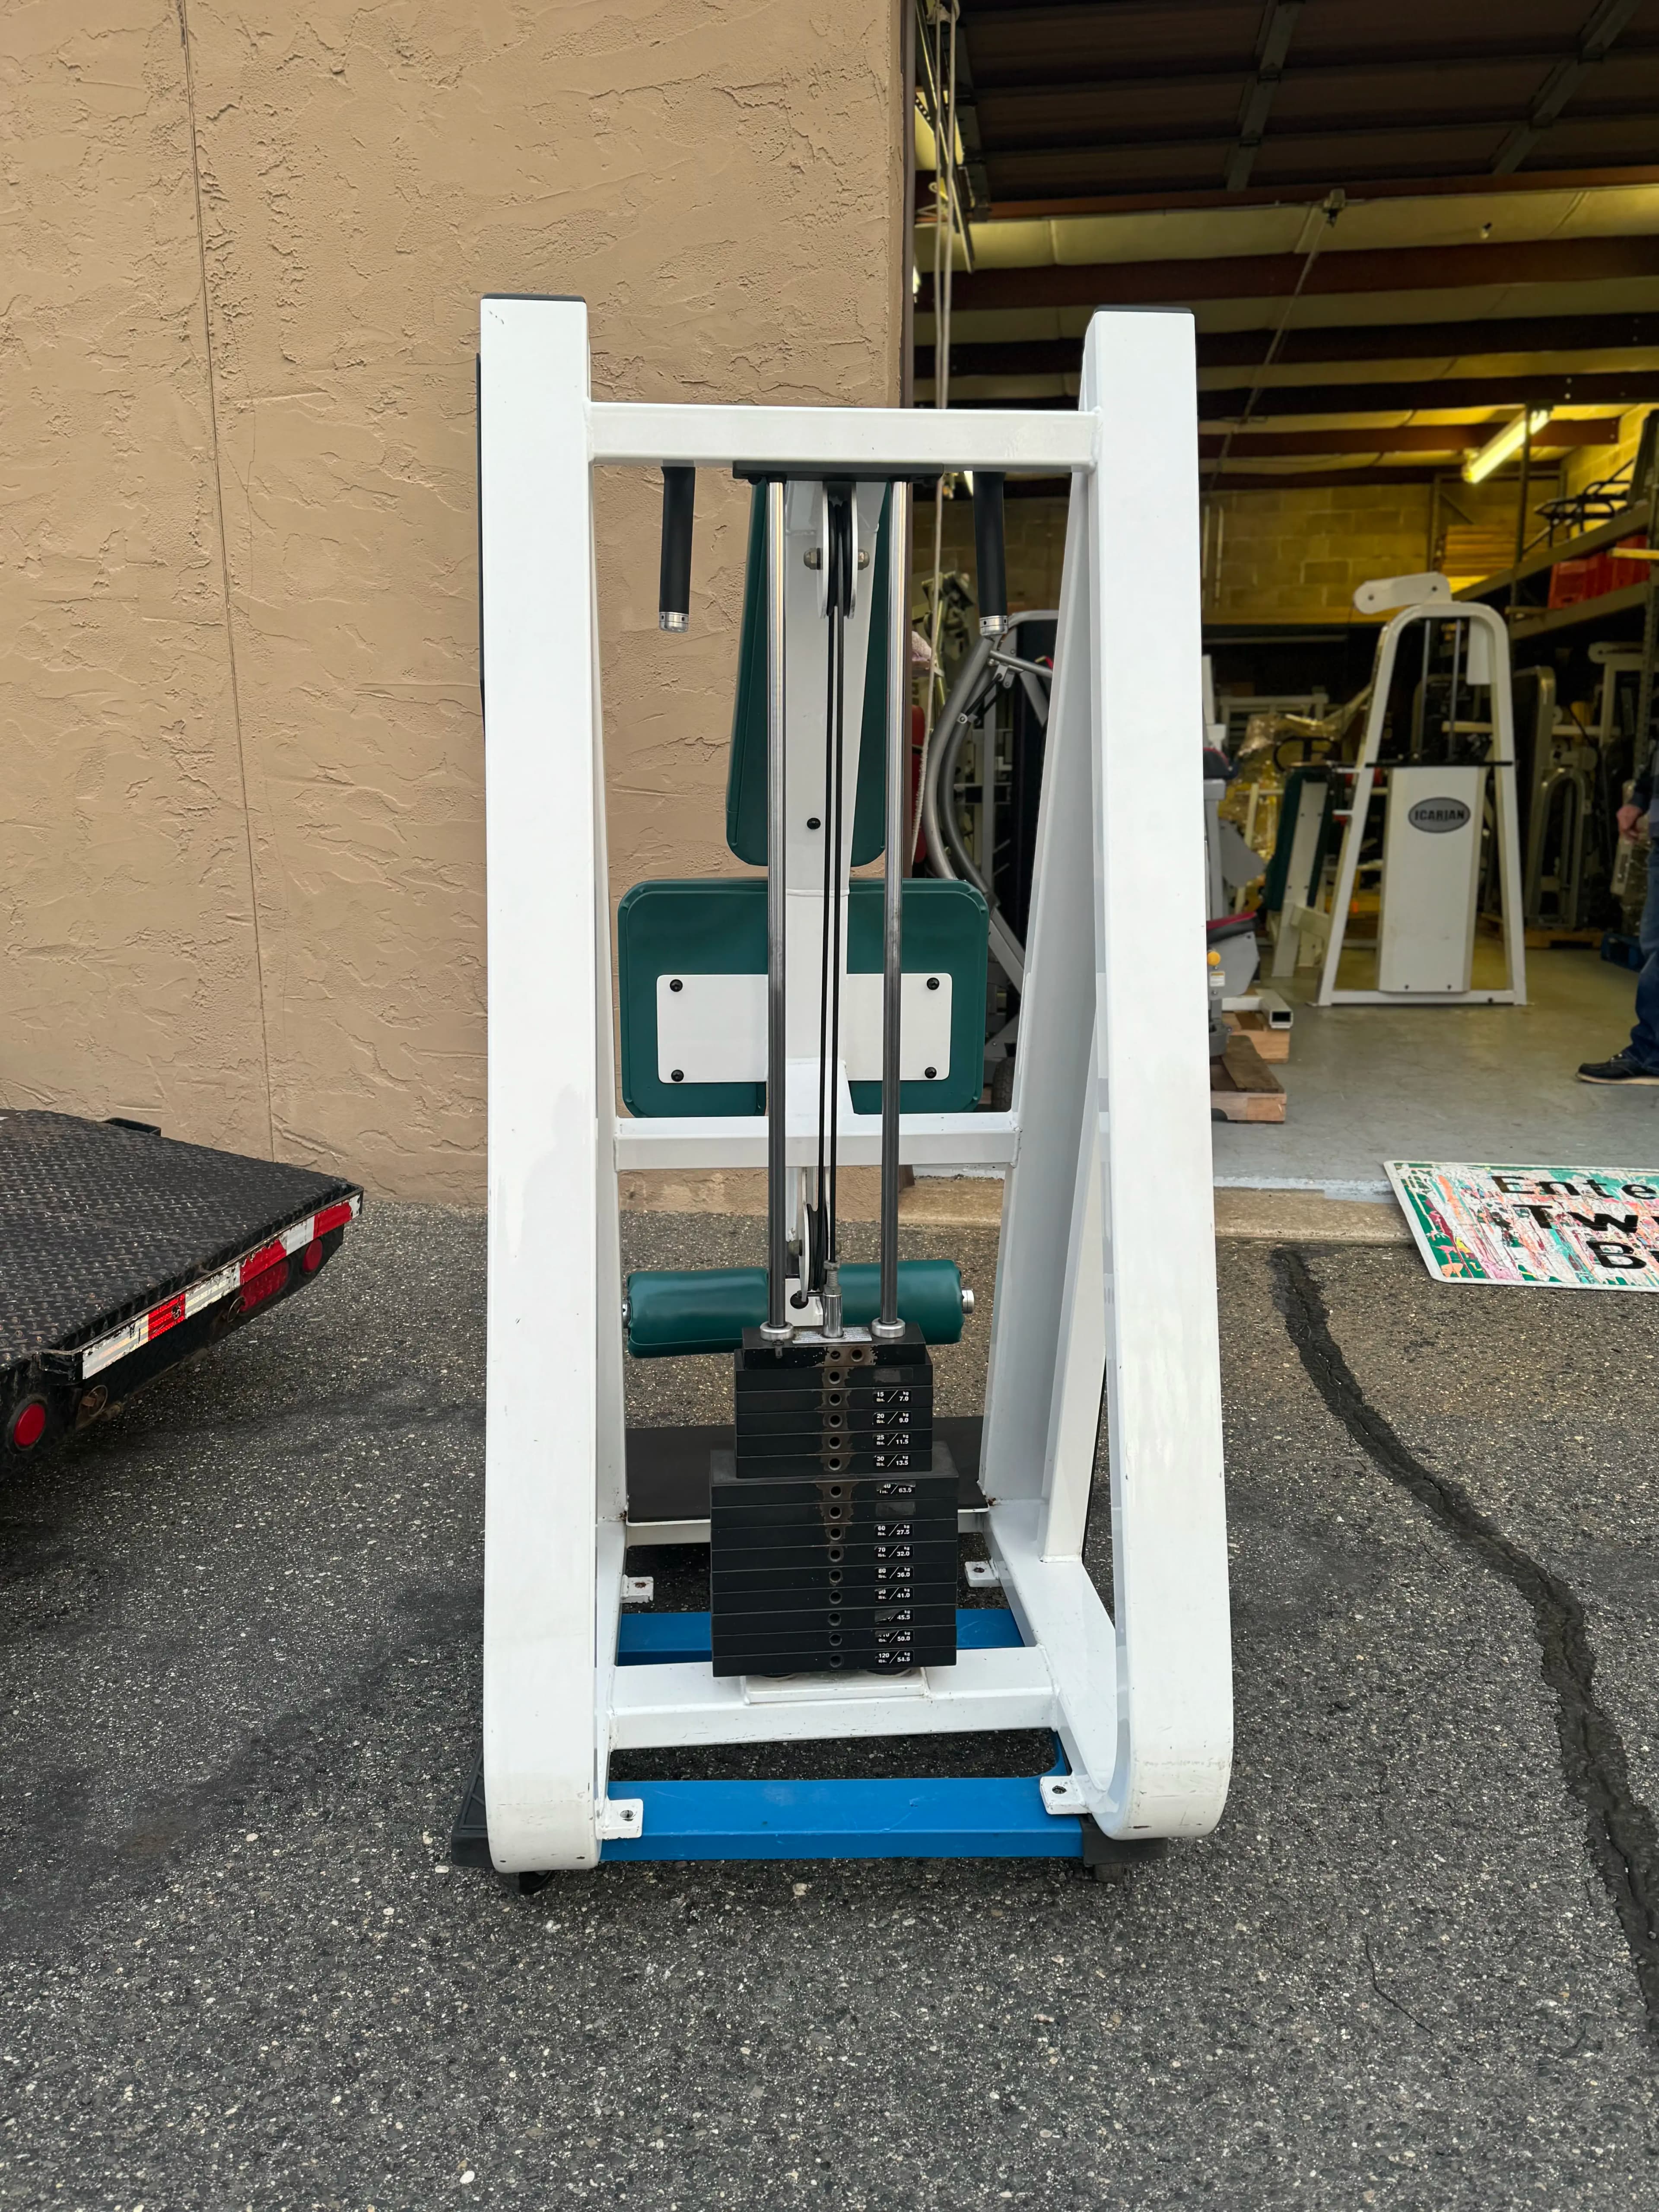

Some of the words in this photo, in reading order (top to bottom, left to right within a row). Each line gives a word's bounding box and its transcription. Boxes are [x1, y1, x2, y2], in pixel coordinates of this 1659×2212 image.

[1414, 809, 1464, 821] ICARIAN
[1511, 1204, 1659, 1233] Tw
[1586, 1241, 1659, 1269] B
